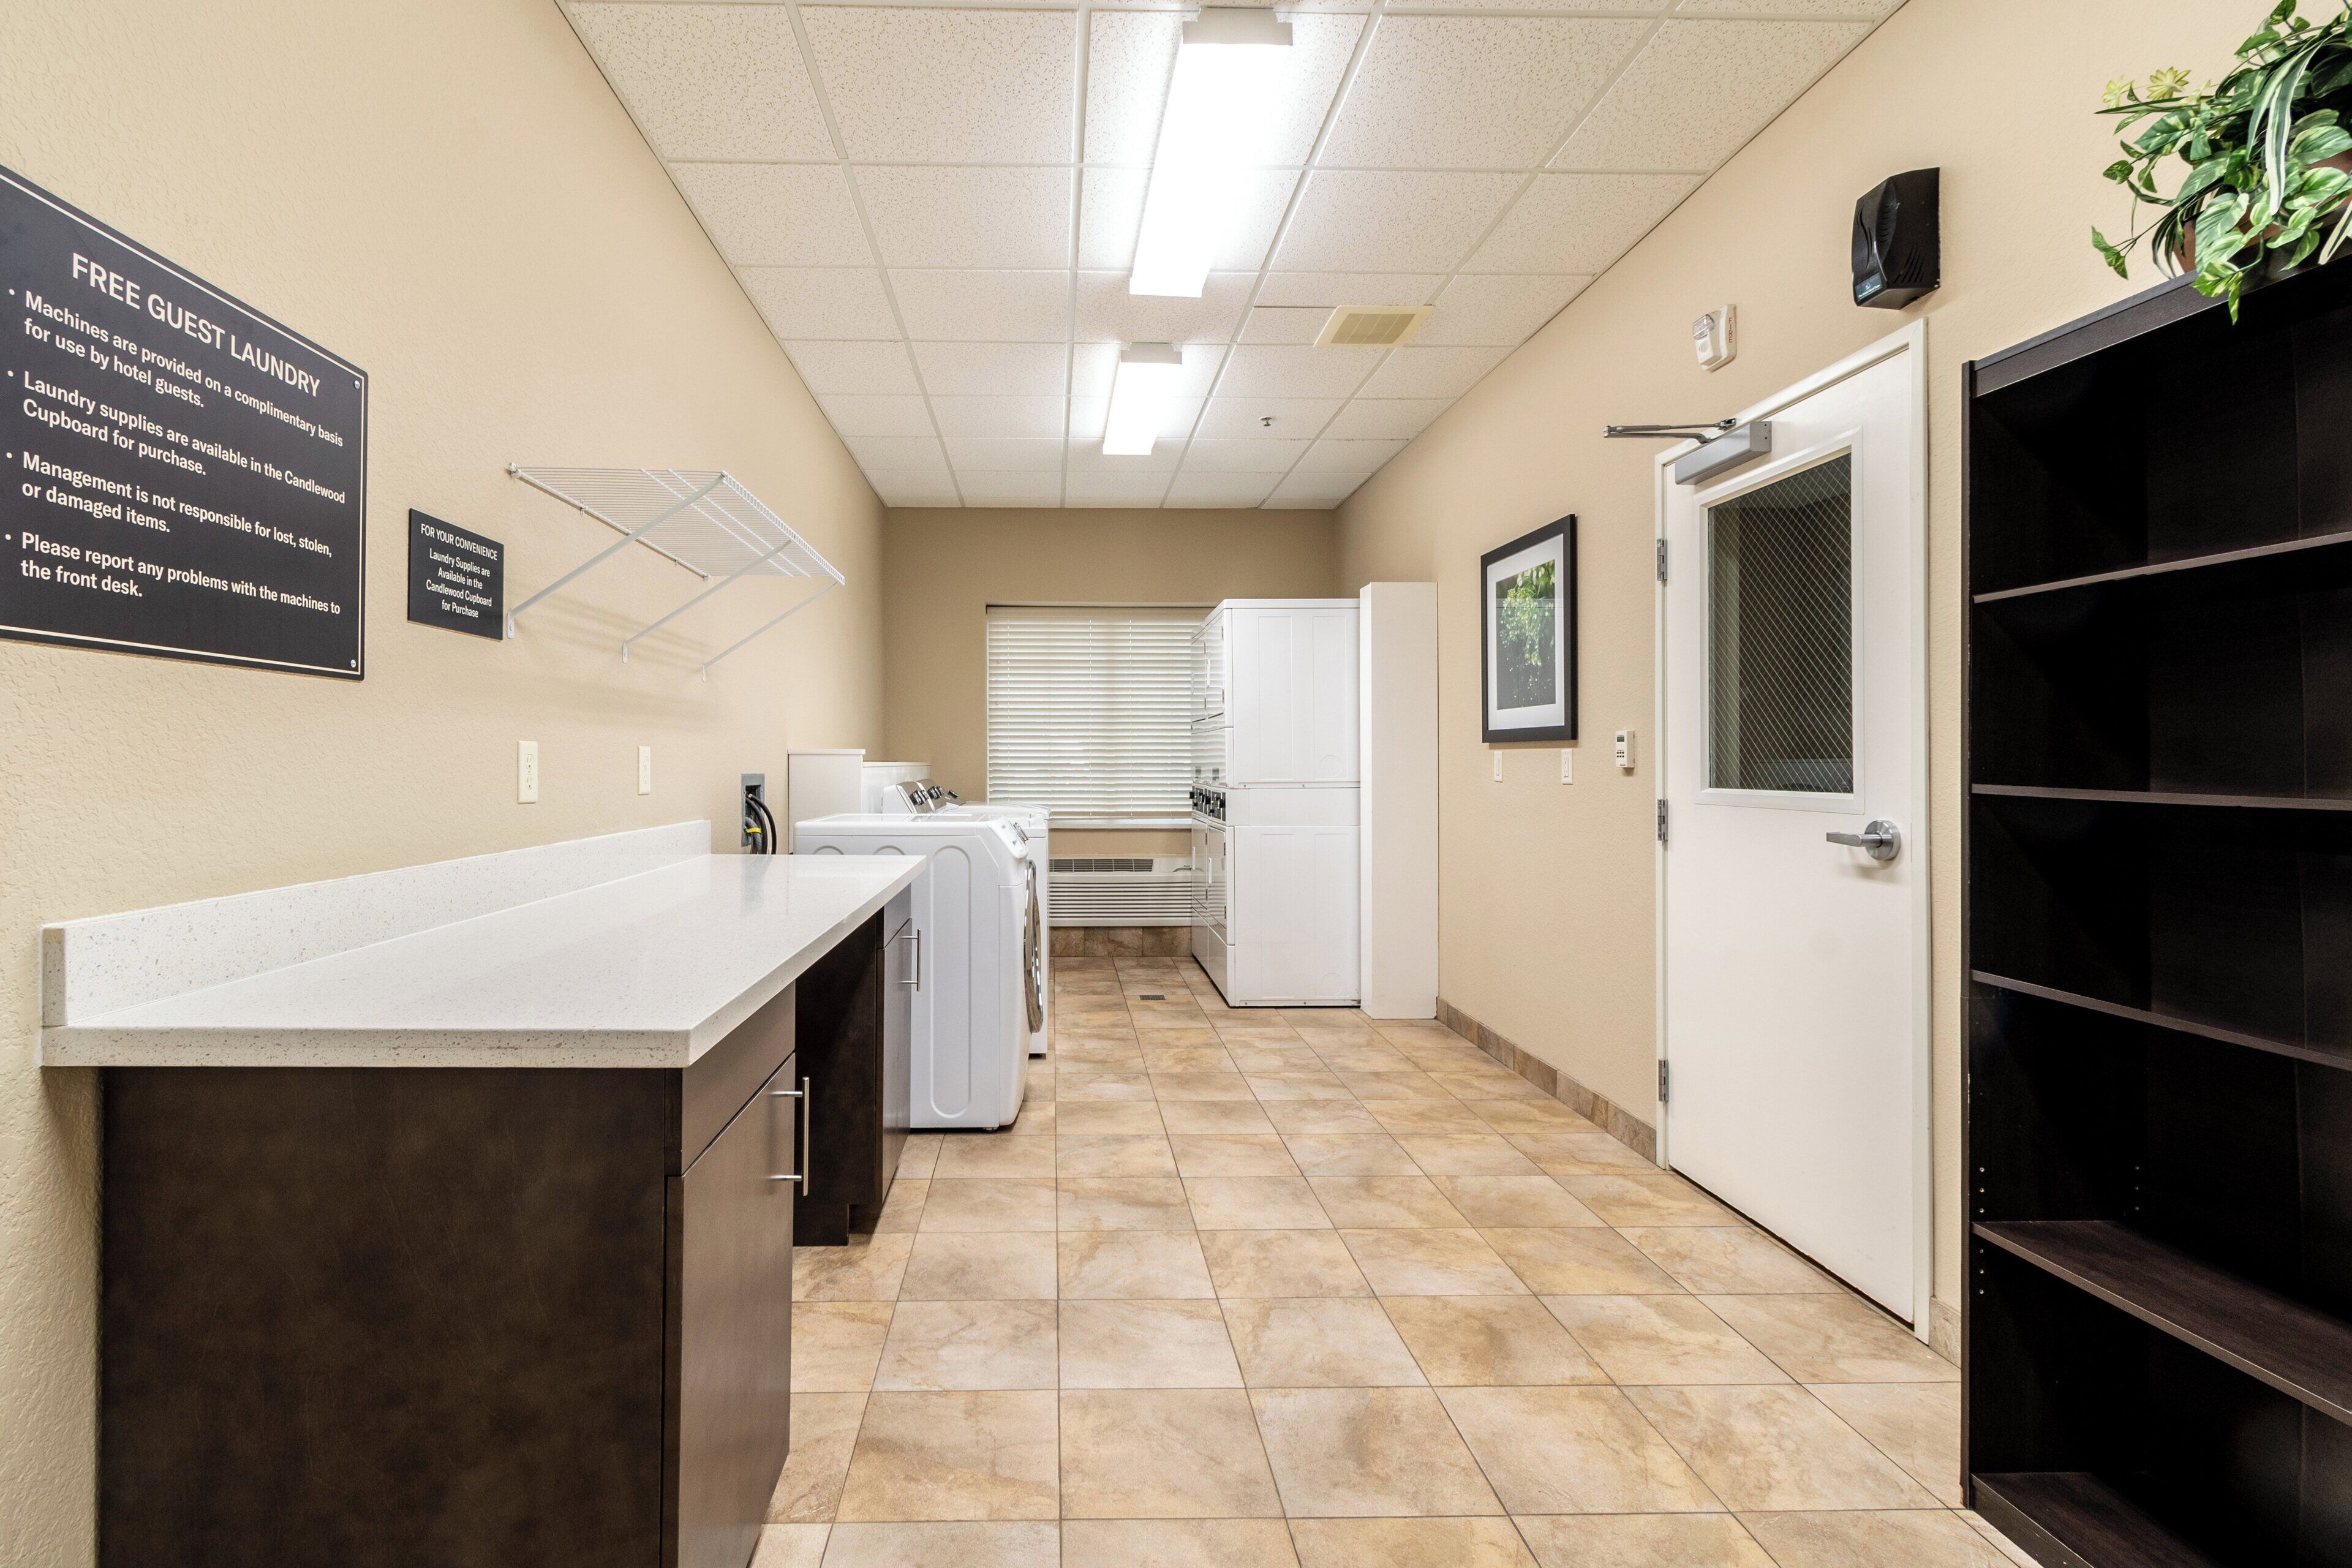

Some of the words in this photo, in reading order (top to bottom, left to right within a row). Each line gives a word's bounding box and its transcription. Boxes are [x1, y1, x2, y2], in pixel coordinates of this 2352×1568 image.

[73, 252, 140, 309] FREE
[148, 294, 225, 349] GUEST
[231, 334, 320, 397] LAUNDRY
[24, 318, 50, 342] for
[56, 335, 85, 357] use
[91, 345, 109, 370] by
[114, 355, 151, 385] hotel
[156, 379, 204, 407] guests.
[26, 290, 108, 342] Machines
[113, 336, 137, 355] are
[142, 348, 201, 384] provided
[205, 377, 221, 393] on
[224, 386, 231, 397] a
[235, 391, 316, 437] complimentary
[318, 424, 343, 447] basis
[23, 399, 108, 442] Cupboard
[113, 430, 135, 450] for
[139, 443, 206, 475] purchase.
[25, 371, 96, 415] Laundry
[100, 404, 163, 437] supplies
[167, 430, 189, 446] are
[192, 439, 247, 467] available
[251, 457, 261, 473] in
[264, 463, 282, 480] the
[285, 470, 345, 503] Candlewood
[22, 483, 41, 498] or
[46, 486, 121, 519] damaged
[127, 507, 170, 532] items.
[24, 451, 132, 499] Management
[136, 486, 148, 503] is
[153, 495, 176, 511] not
[179, 502, 252, 532] responsible
[255, 521, 271, 538] for
[274, 527, 296, 548] lost,
[299, 538, 331, 557] stolen,
[23, 532, 80, 559] Please
[86, 551, 134, 571] report
[138, 562, 164, 580] any
[168, 568, 228, 590] problems
[232, 581, 256, 597] with
[259, 586, 277, 601] the
[281, 594, 328, 612] machines
[331, 602, 340, 614] to
[421, 524, 435, 538] FOR
[436, 529, 454, 545] YOUR
[455, 537, 497, 560] CONVENIENCE
[430, 548, 454, 567] Laundry
[456, 557, 480, 574] Supplies
[481, 568, 490, 577] are
[21, 560, 51, 579] the
[56, 566, 97, 589] front
[102, 575, 142, 597] desk.
[426, 579, 464, 599] Candlewood
[465, 590, 492, 606] Cupboard
[438, 567, 466, 584] Available
[467, 576, 472, 586] in
[473, 578, 483, 589] the
[442, 599, 451, 611] for
[452, 602, 478, 617] Purchase
